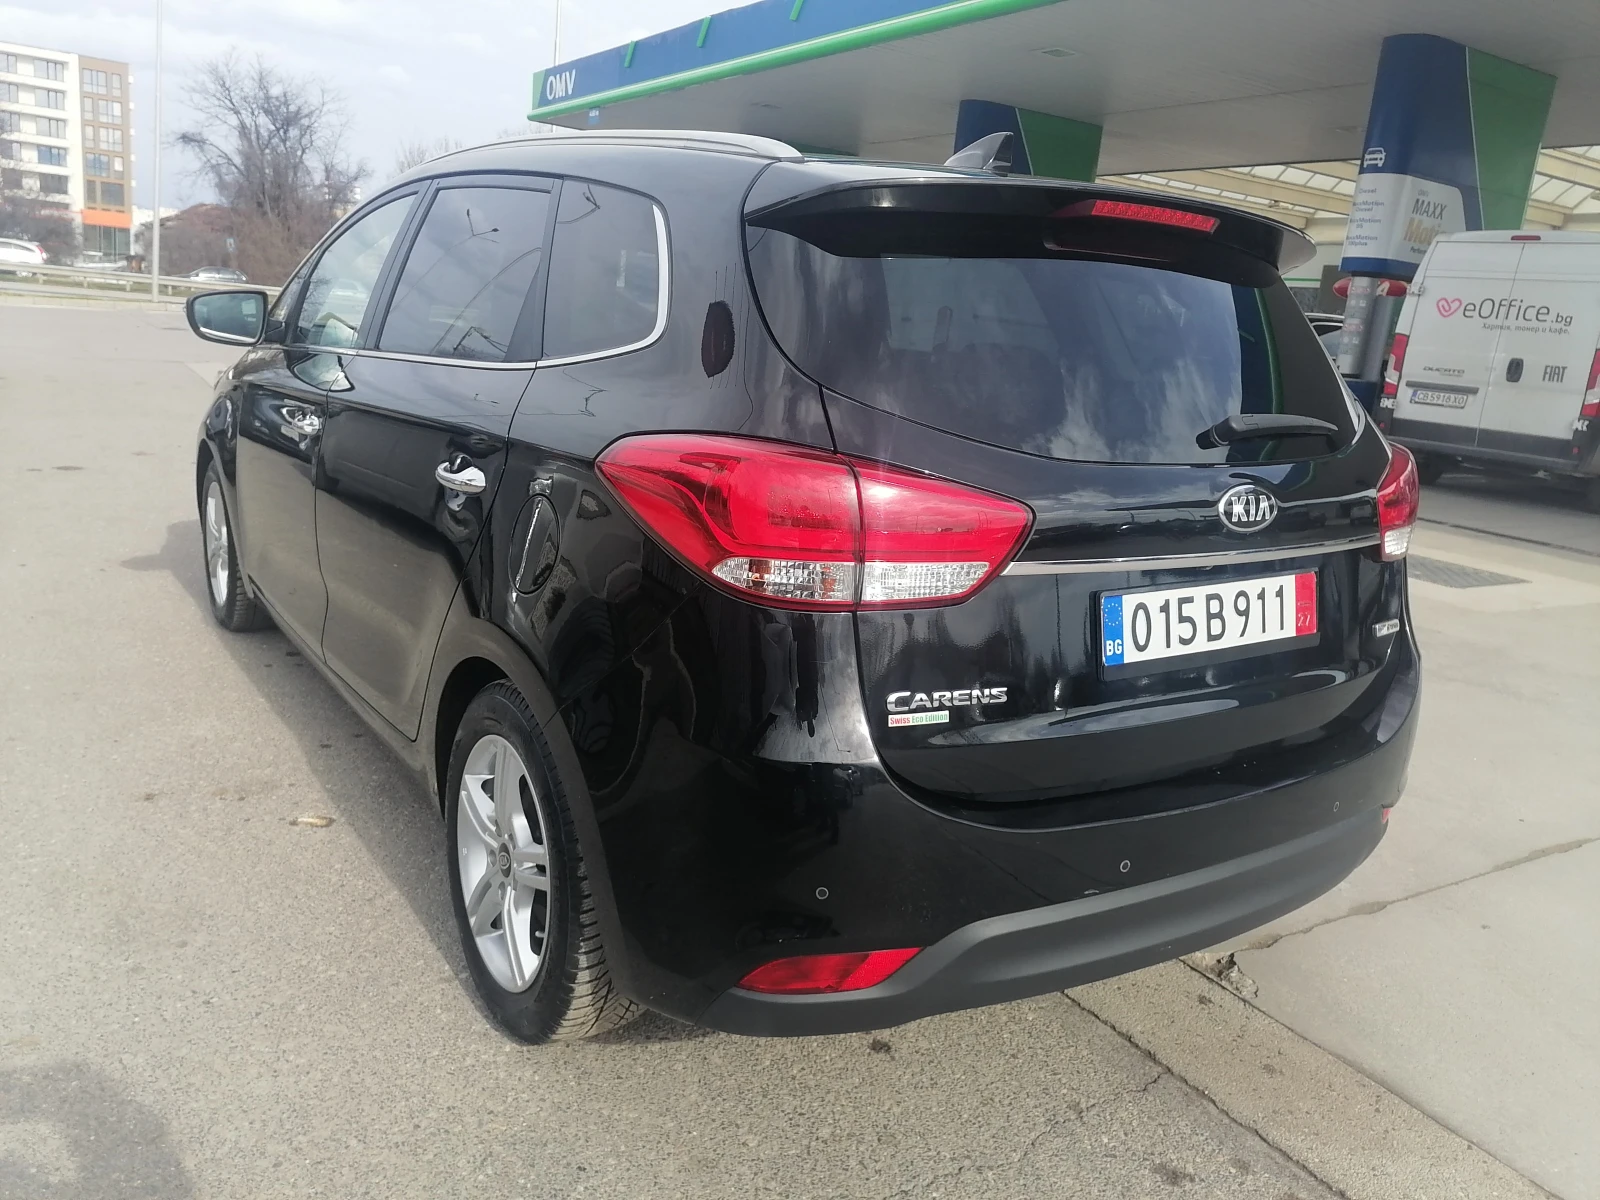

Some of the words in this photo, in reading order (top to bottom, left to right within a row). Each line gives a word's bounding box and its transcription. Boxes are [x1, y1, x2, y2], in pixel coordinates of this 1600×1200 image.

[546, 68, 576, 100] OMV
[1411, 198, 1448, 220] MAXX
[1542, 365, 1568, 383] FIAT
[1231, 495, 1271, 522] KIA
[1106, 638, 1123, 655] BG
[886, 687, 1008, 712] CARENS
[890, 716, 911, 726] Swiss
[911, 715, 925, 723] Eco
[925, 712, 948, 722] Edition
